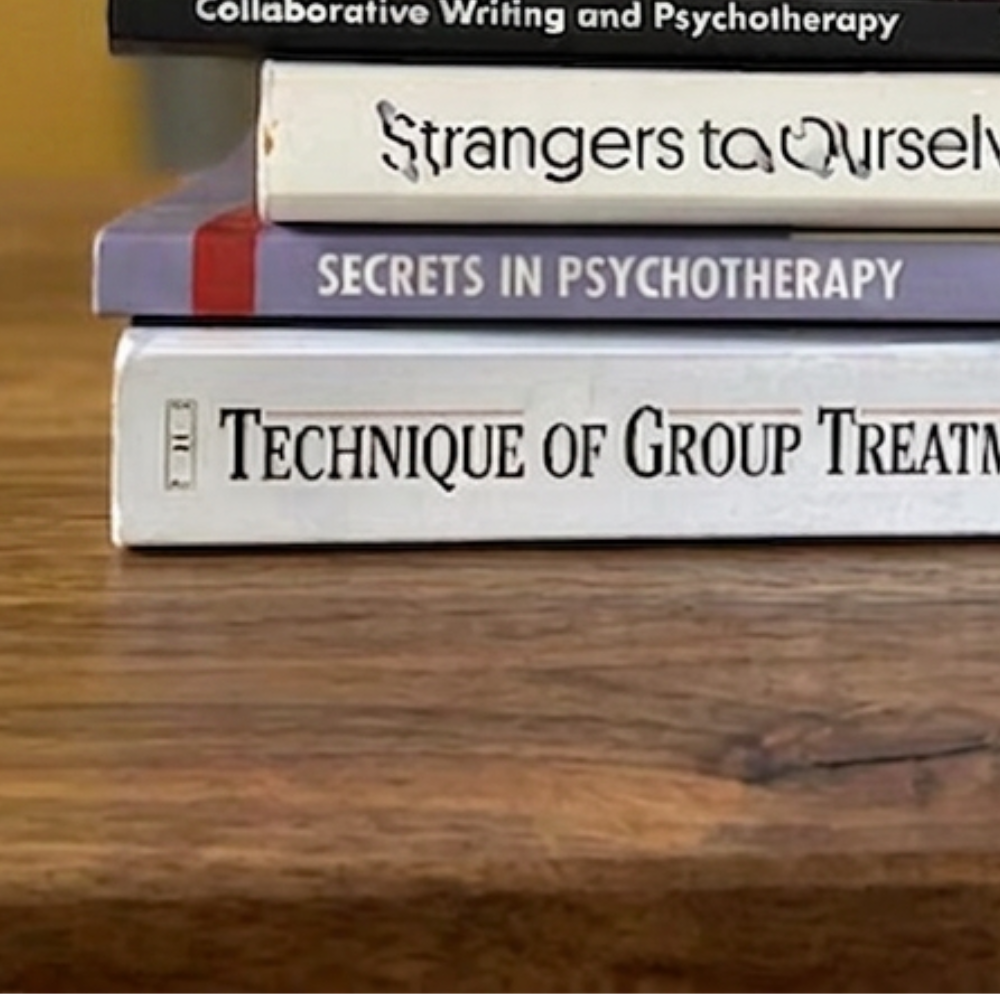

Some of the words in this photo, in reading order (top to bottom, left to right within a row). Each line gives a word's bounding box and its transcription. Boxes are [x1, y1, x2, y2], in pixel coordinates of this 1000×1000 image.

[438, 0, 566, 34] Writing
[578, 3, 643, 30] and
[654, 3, 900, 42] Psychotherapy
[378, 101, 684, 182] Strangers
[699, 120, 774, 173] to
[317, 253, 485, 296] SECRETS
[501, 256, 540, 296] IN
[558, 257, 903, 301] PSYCHOTHERAPY
[543, 422, 607, 479] OF
